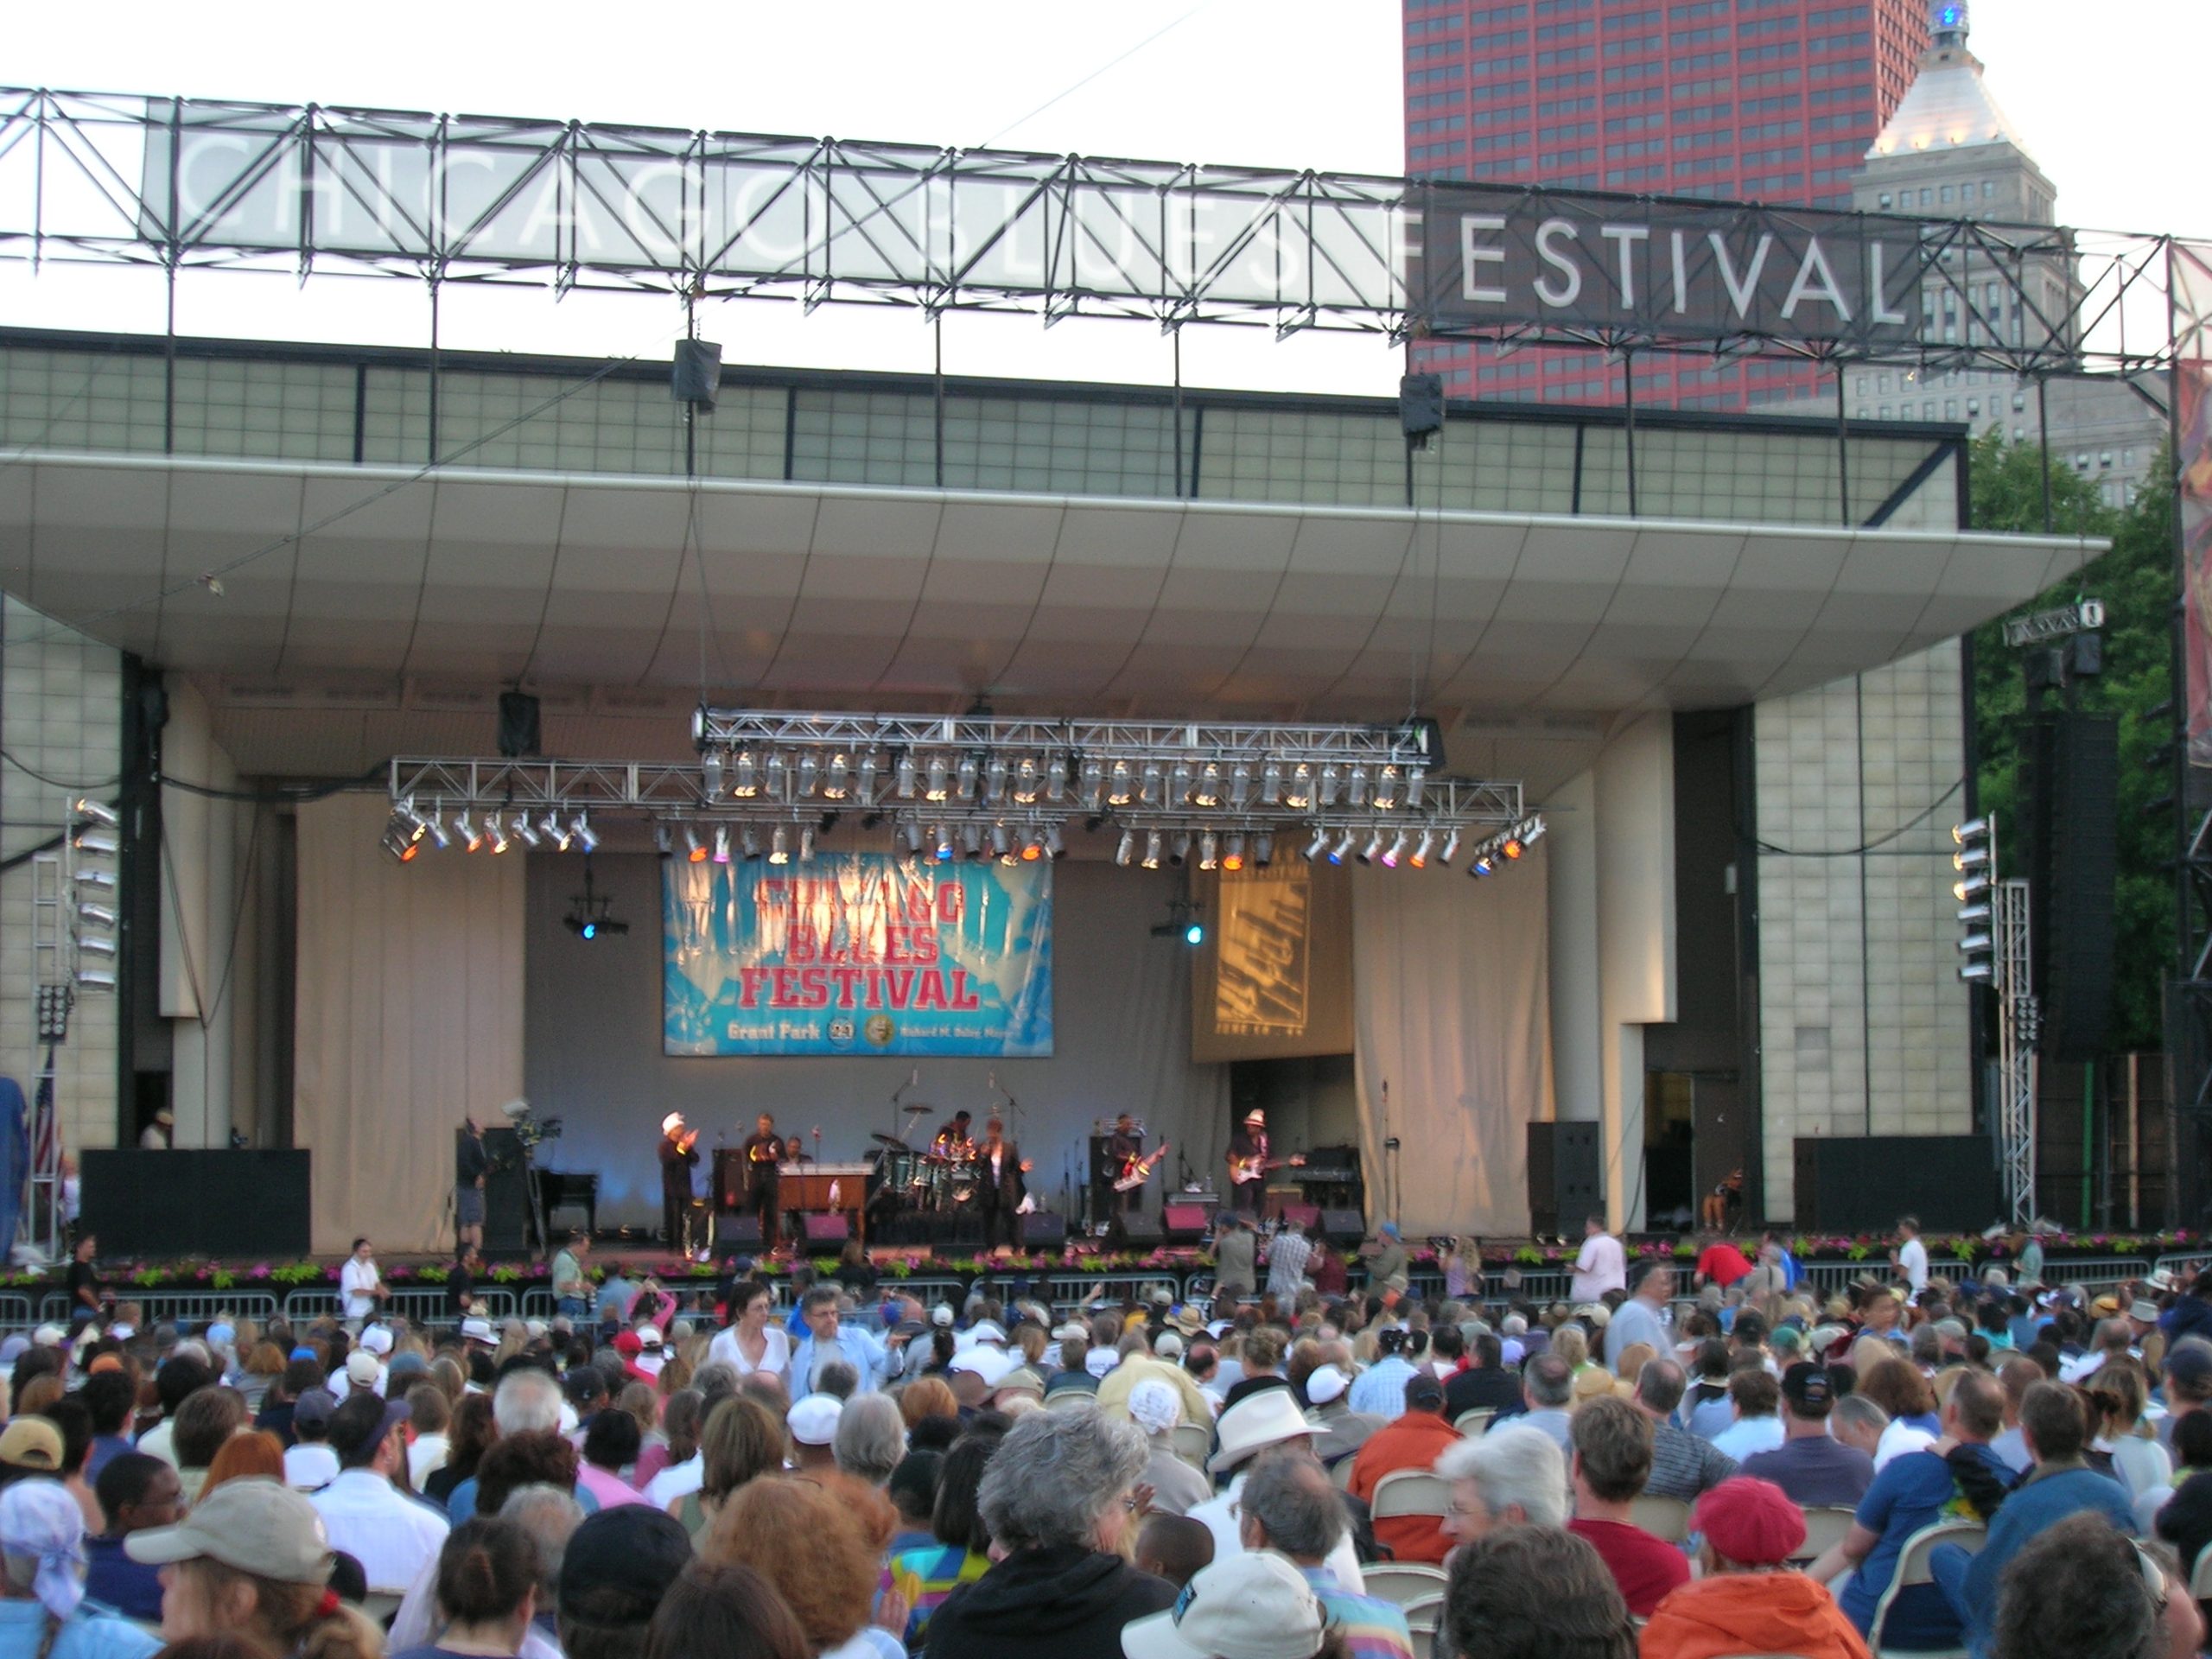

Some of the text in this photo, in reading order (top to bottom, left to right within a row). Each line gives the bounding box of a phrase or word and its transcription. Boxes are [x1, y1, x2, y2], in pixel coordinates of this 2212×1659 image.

[177, 133, 1906, 325] CHICAGO BLUES FESTIVAL
[753, 878, 965, 924] CHIAGO
[785, 923, 940, 966] BLUES
[739, 967, 980, 1009] FESTIVAL
[727, 1021, 820, 1039] Grant Park
